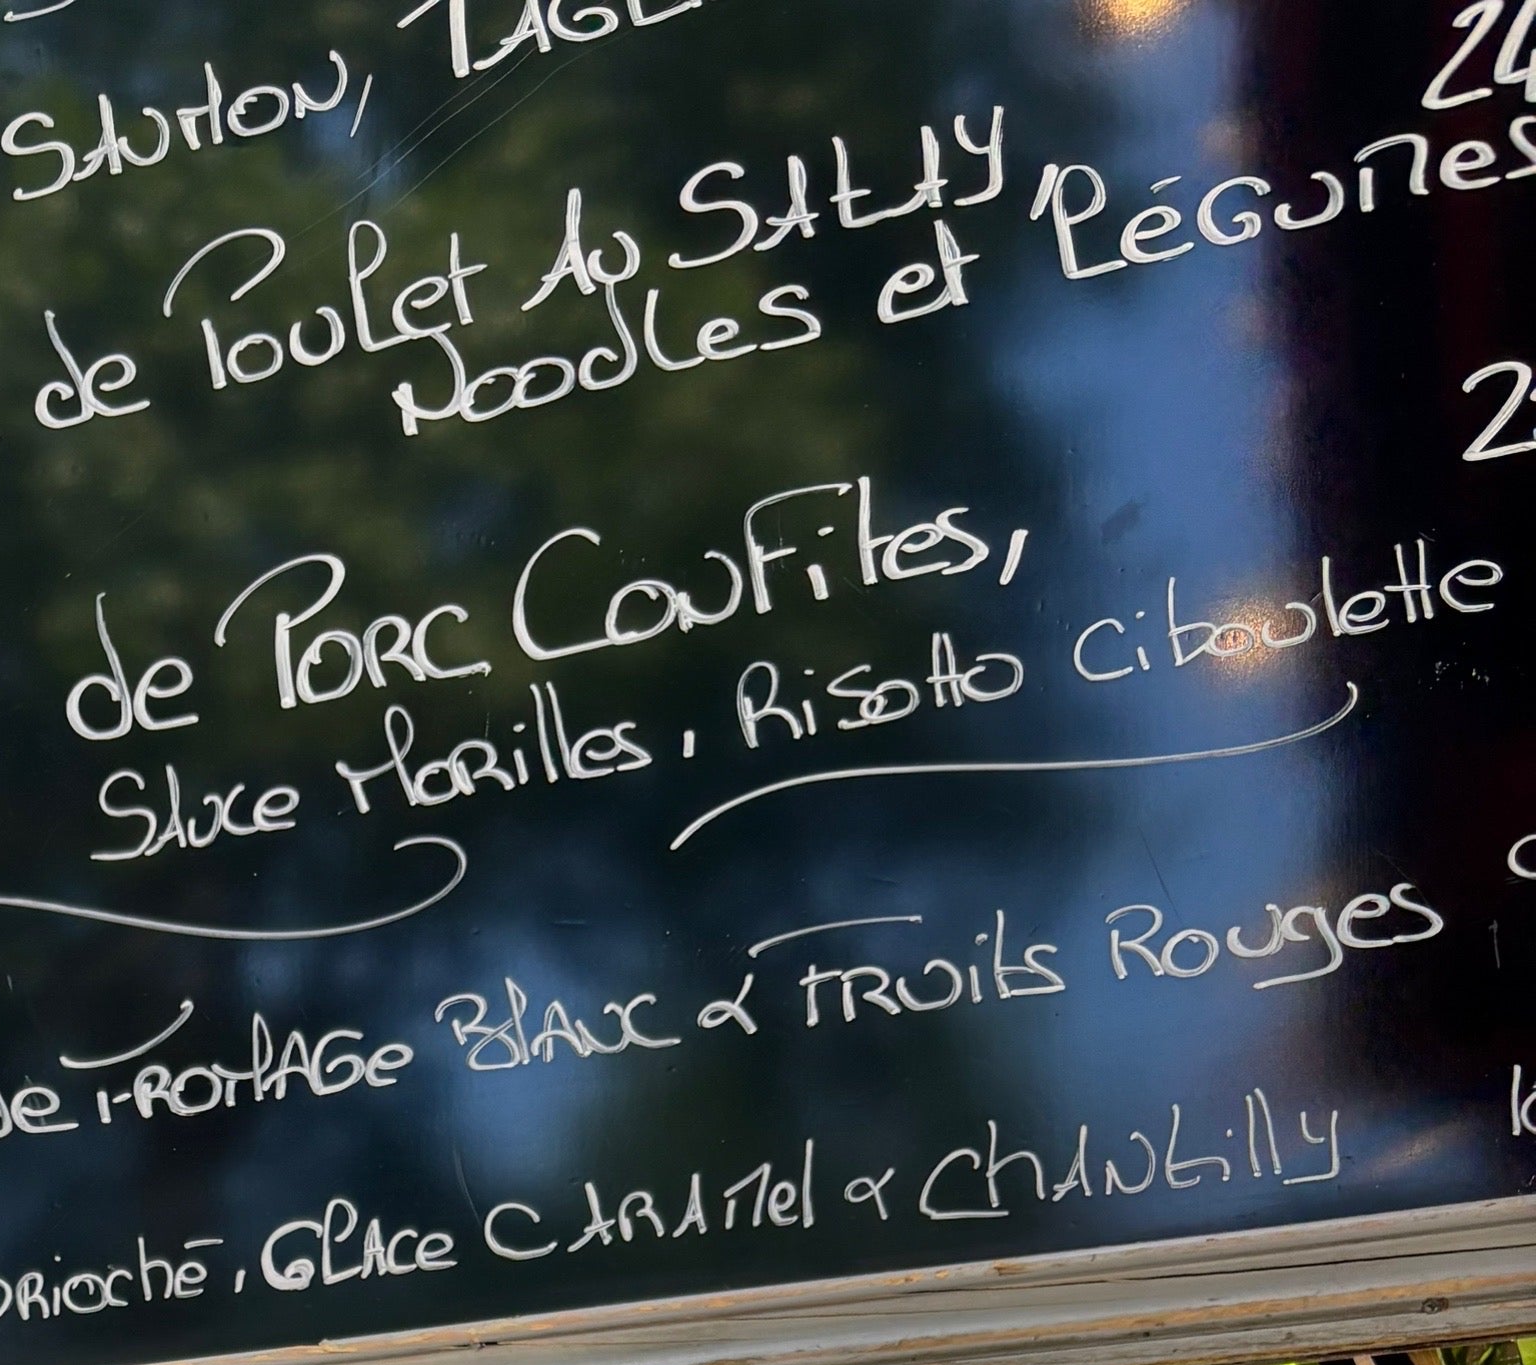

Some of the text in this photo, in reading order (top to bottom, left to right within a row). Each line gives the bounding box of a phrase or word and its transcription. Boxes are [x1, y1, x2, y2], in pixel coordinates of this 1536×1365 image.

[876, 219, 981, 324] et
[34, 309, 151, 430] de
[1461, 360, 1536, 462] 2
[65, 591, 200, 741] de
